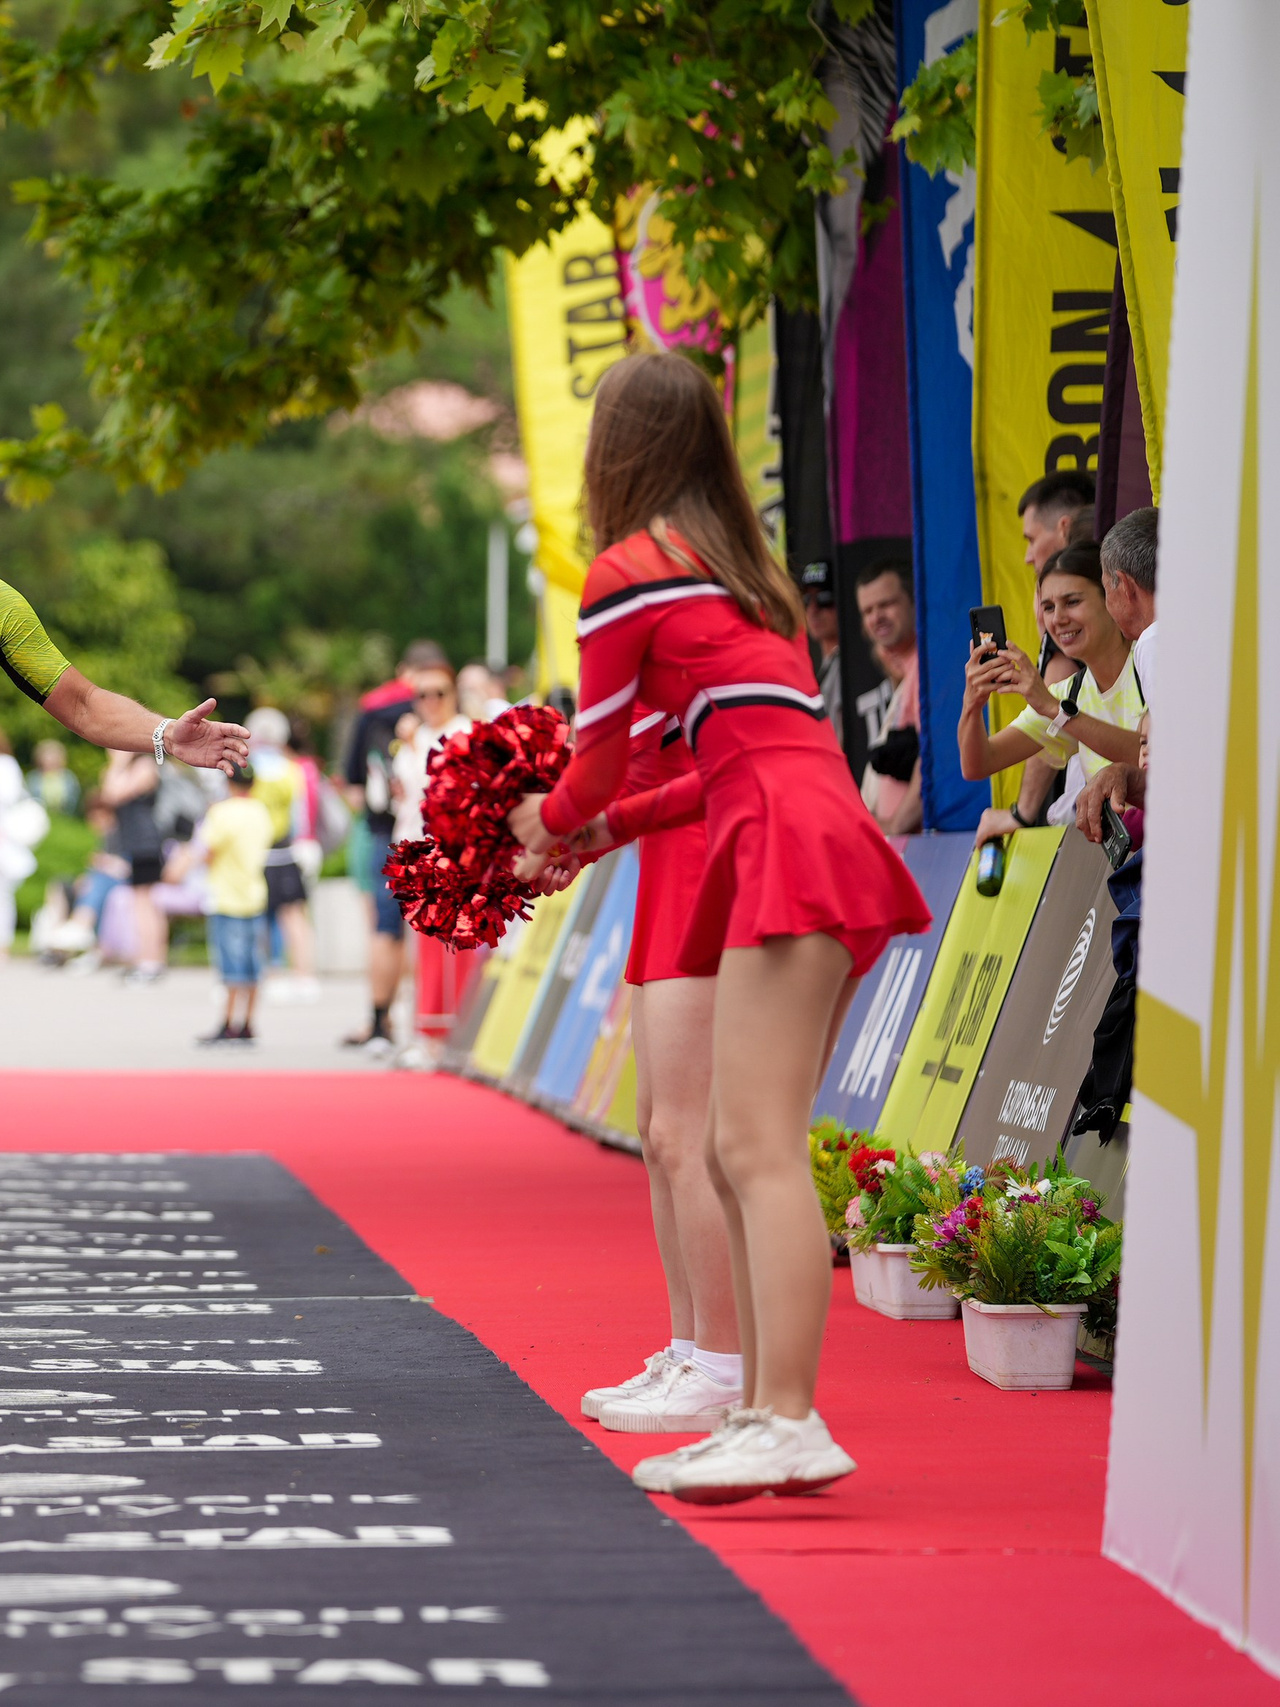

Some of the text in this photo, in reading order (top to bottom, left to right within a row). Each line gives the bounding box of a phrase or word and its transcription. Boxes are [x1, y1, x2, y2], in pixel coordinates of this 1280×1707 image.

[955, 952, 1003, 1047] STAR
[31, 1358, 324, 1373] STAR
[47, 1431, 382, 1448] STAR
[64, 1525, 454, 1548] STAR
[80, 1656, 551, 1688] STAR
